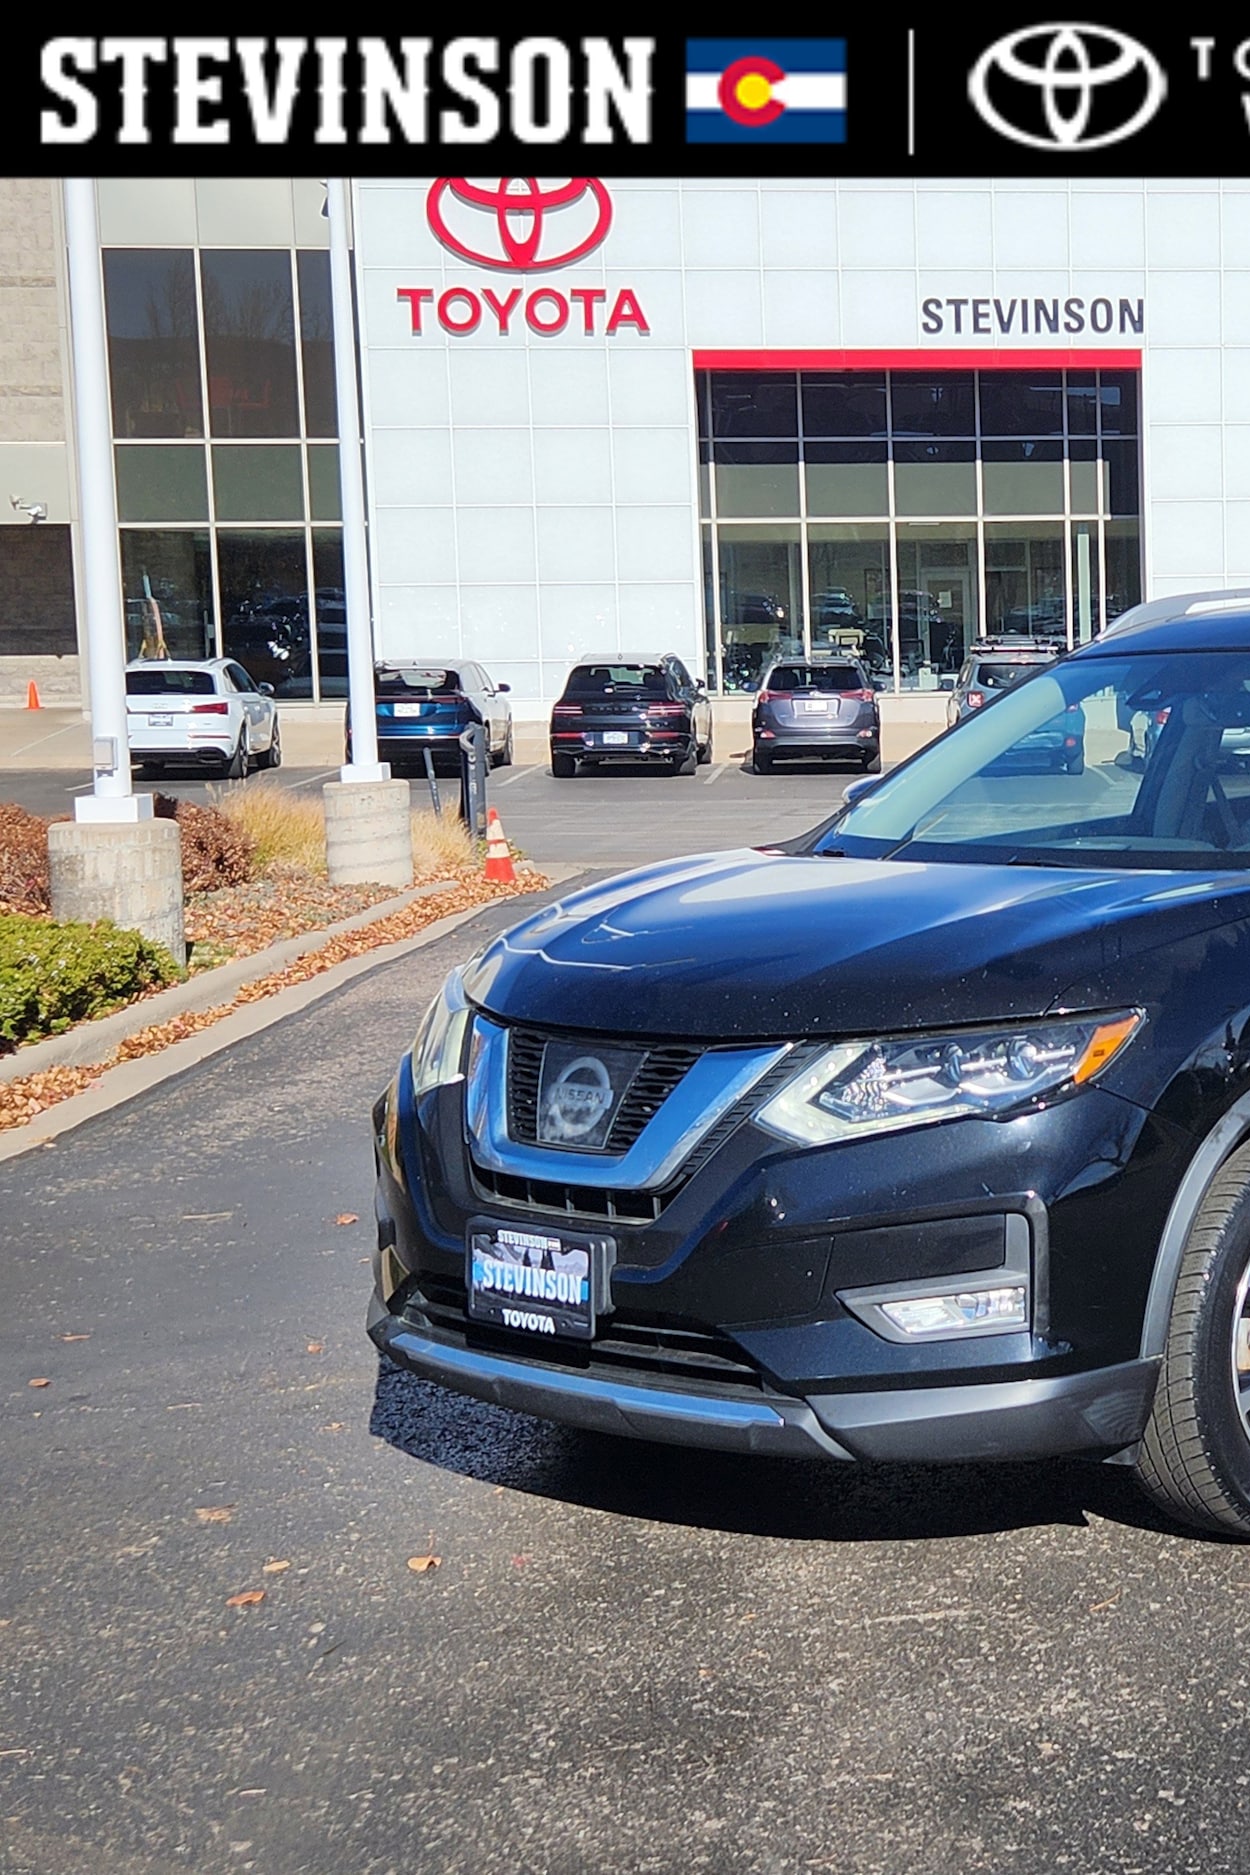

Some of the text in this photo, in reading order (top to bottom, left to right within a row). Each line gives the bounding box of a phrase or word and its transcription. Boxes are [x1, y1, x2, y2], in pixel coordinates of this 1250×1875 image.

[397, 287, 650, 338] TOYOTA
[921, 297, 1145, 335] STEVINSON
[555, 1086, 606, 1105] NISSAN
[482, 1259, 582, 1305] STEVINSON
[501, 1308, 556, 1335] TOYOTA
